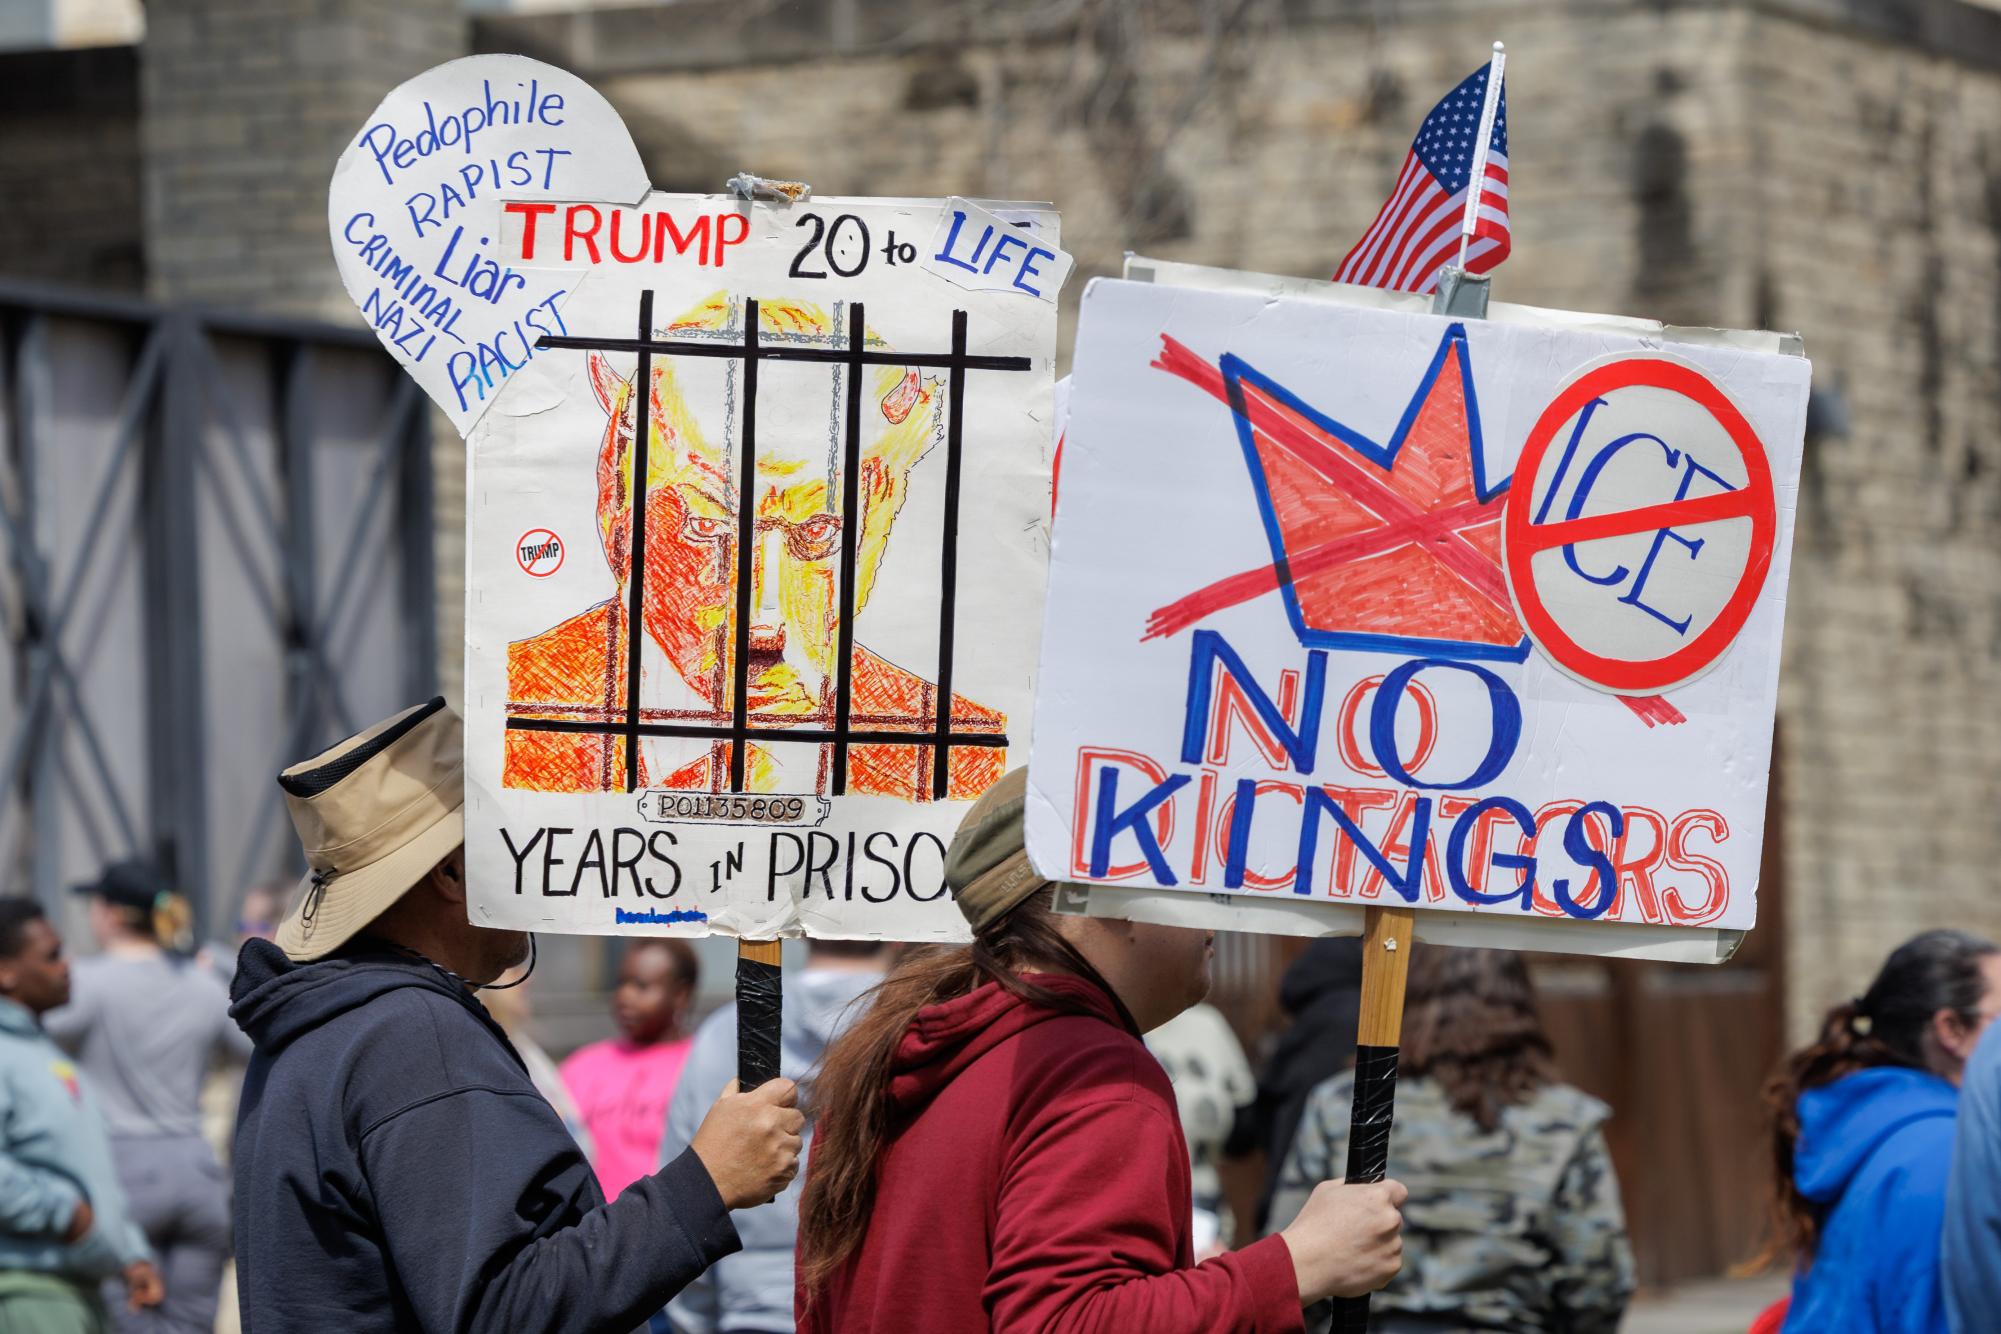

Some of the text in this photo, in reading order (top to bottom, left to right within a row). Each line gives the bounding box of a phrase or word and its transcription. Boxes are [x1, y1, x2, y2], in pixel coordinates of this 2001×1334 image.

[359, 79, 565, 185] Pedophile
[405, 148, 571, 238] RAPIST
[434, 226, 525, 304] Liar
[503, 203, 1056, 298] TRUMP 20 to LIFE
[363, 288, 437, 362] NAZI
[446, 290, 569, 412] RACIST
[520, 542, 560, 562] TRUMP
[1532, 396, 1738, 637] ICE
[1181, 629, 1523, 790] NO
[500, 827, 956, 902] YEARS IN PRISO
[1090, 765, 1624, 920] KINGS
